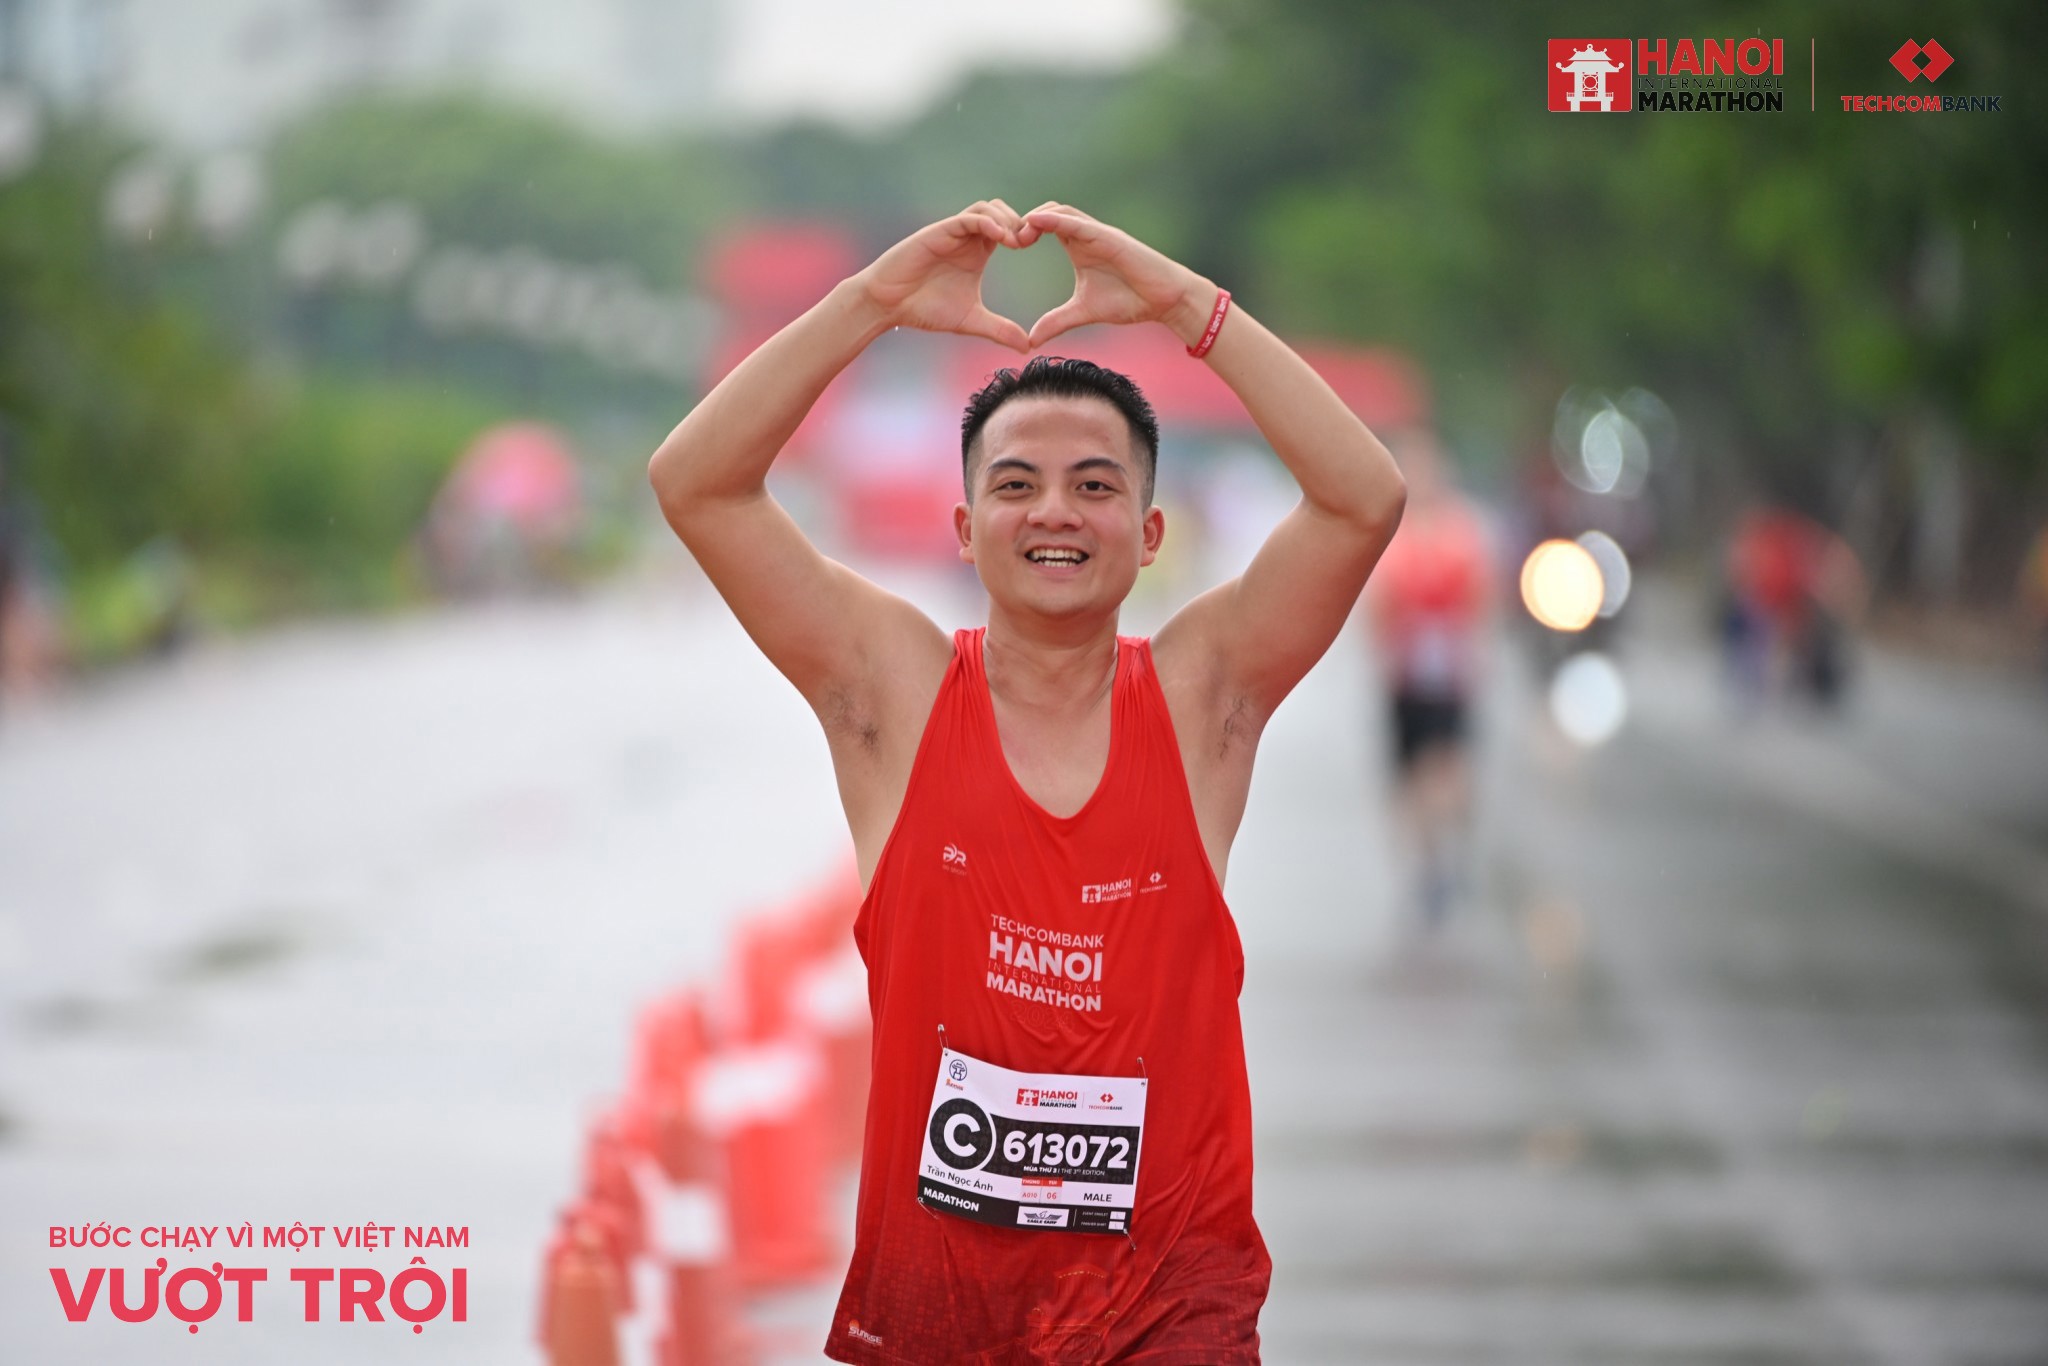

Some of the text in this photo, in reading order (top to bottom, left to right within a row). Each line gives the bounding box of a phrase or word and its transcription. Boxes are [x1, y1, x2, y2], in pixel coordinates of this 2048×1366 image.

[1102, 878, 1132, 893] HANOI
[1102, 891, 1132, 902] MARATHON
[990, 914, 1104, 948] TECHCOMBANK
[989, 931, 1103, 982] HANOI
[988, 960, 1101, 993] INTERNATIONAL
[986, 971, 1101, 1012] MARATHON
[1041, 1090, 1078, 1100] HANOI
[943, 1112, 980, 1157] C
[1003, 1130, 1130, 1169] 613072
[927, 1165, 946, 1178] Trần
[947, 1172, 972, 1187] Ngọc
[923, 1187, 980, 1212] MARATHON
[1046, 1192, 1057, 1200] 06
[1083, 1193, 1112, 1203] MALE
